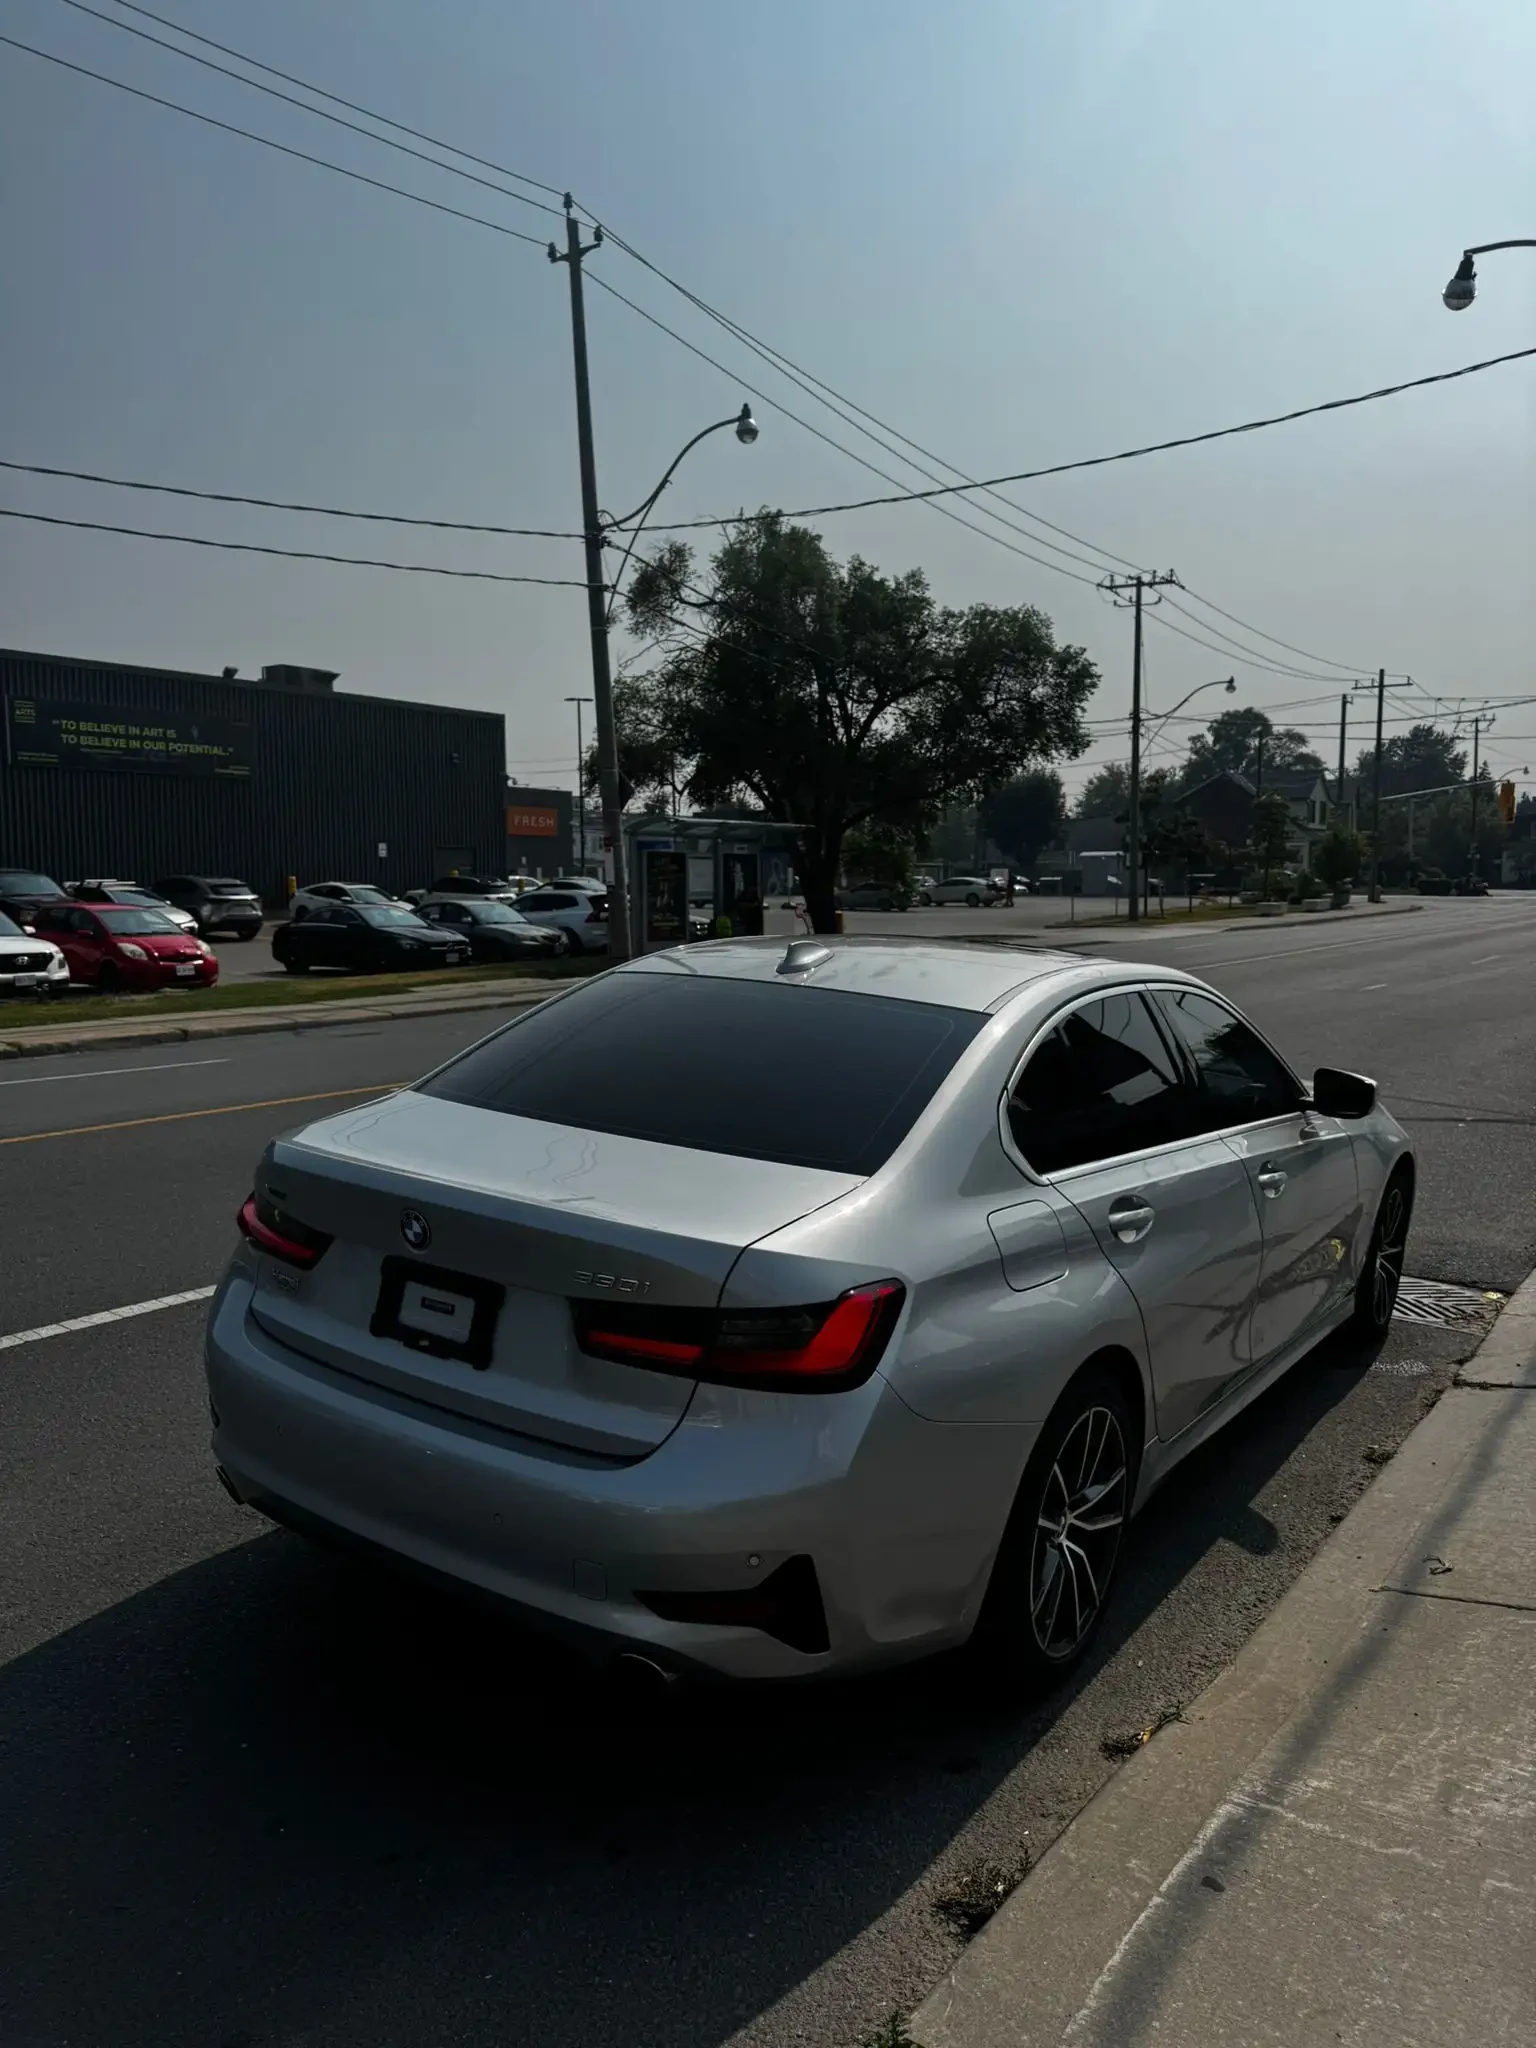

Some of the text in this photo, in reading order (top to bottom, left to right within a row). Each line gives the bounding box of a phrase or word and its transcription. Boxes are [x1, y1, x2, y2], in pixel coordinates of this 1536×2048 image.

[79, 721, 125, 734] BELIEVE
[128, 725, 140, 736] IN
[142, 727, 165, 737] ART
[166, 728, 177, 738] IS
[60, 733, 77, 744] TO
[79, 735, 127, 748] BELIEVE
[129, 739, 141, 748] IN
[143, 740, 166, 751] OUR
[513, 815, 554, 828] FRESH
[573, 1269, 651, 1294] 330i
